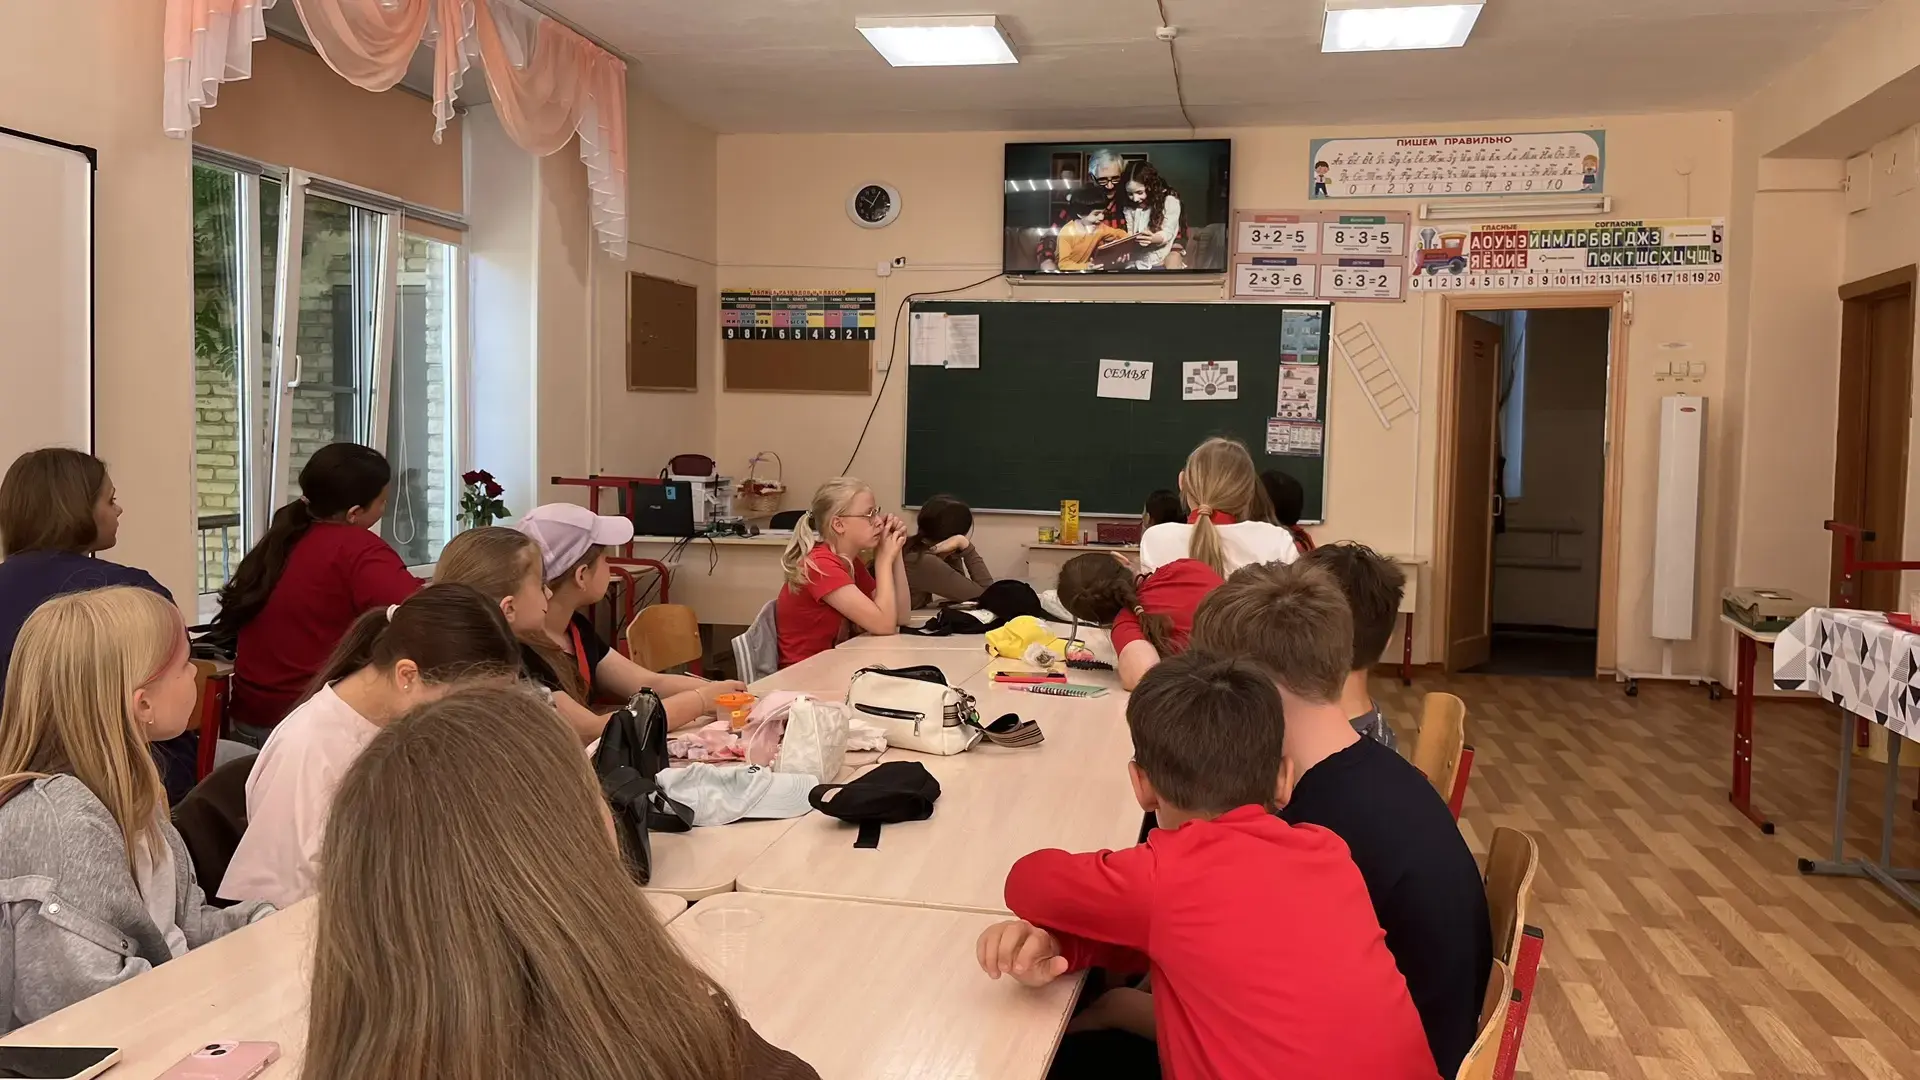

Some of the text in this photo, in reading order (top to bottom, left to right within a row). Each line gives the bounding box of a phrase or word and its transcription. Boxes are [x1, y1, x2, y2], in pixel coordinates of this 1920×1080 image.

[1444, 136, 1512, 145] ПРАВИЛЬНО
[1349, 179, 1563, 195] 0 1 2 3 4 5 6 7 8 9 10
[1413, 272, 1721, 287] 0 1 2 3 4 5 6 7 8 9 10 11 12 13 14 15 16 17 18 19 20
[727, 329, 869, 339] 9 8 7 6 5 4 3 2 1
[1103, 368, 1149, 381] СЕМЬЯ
